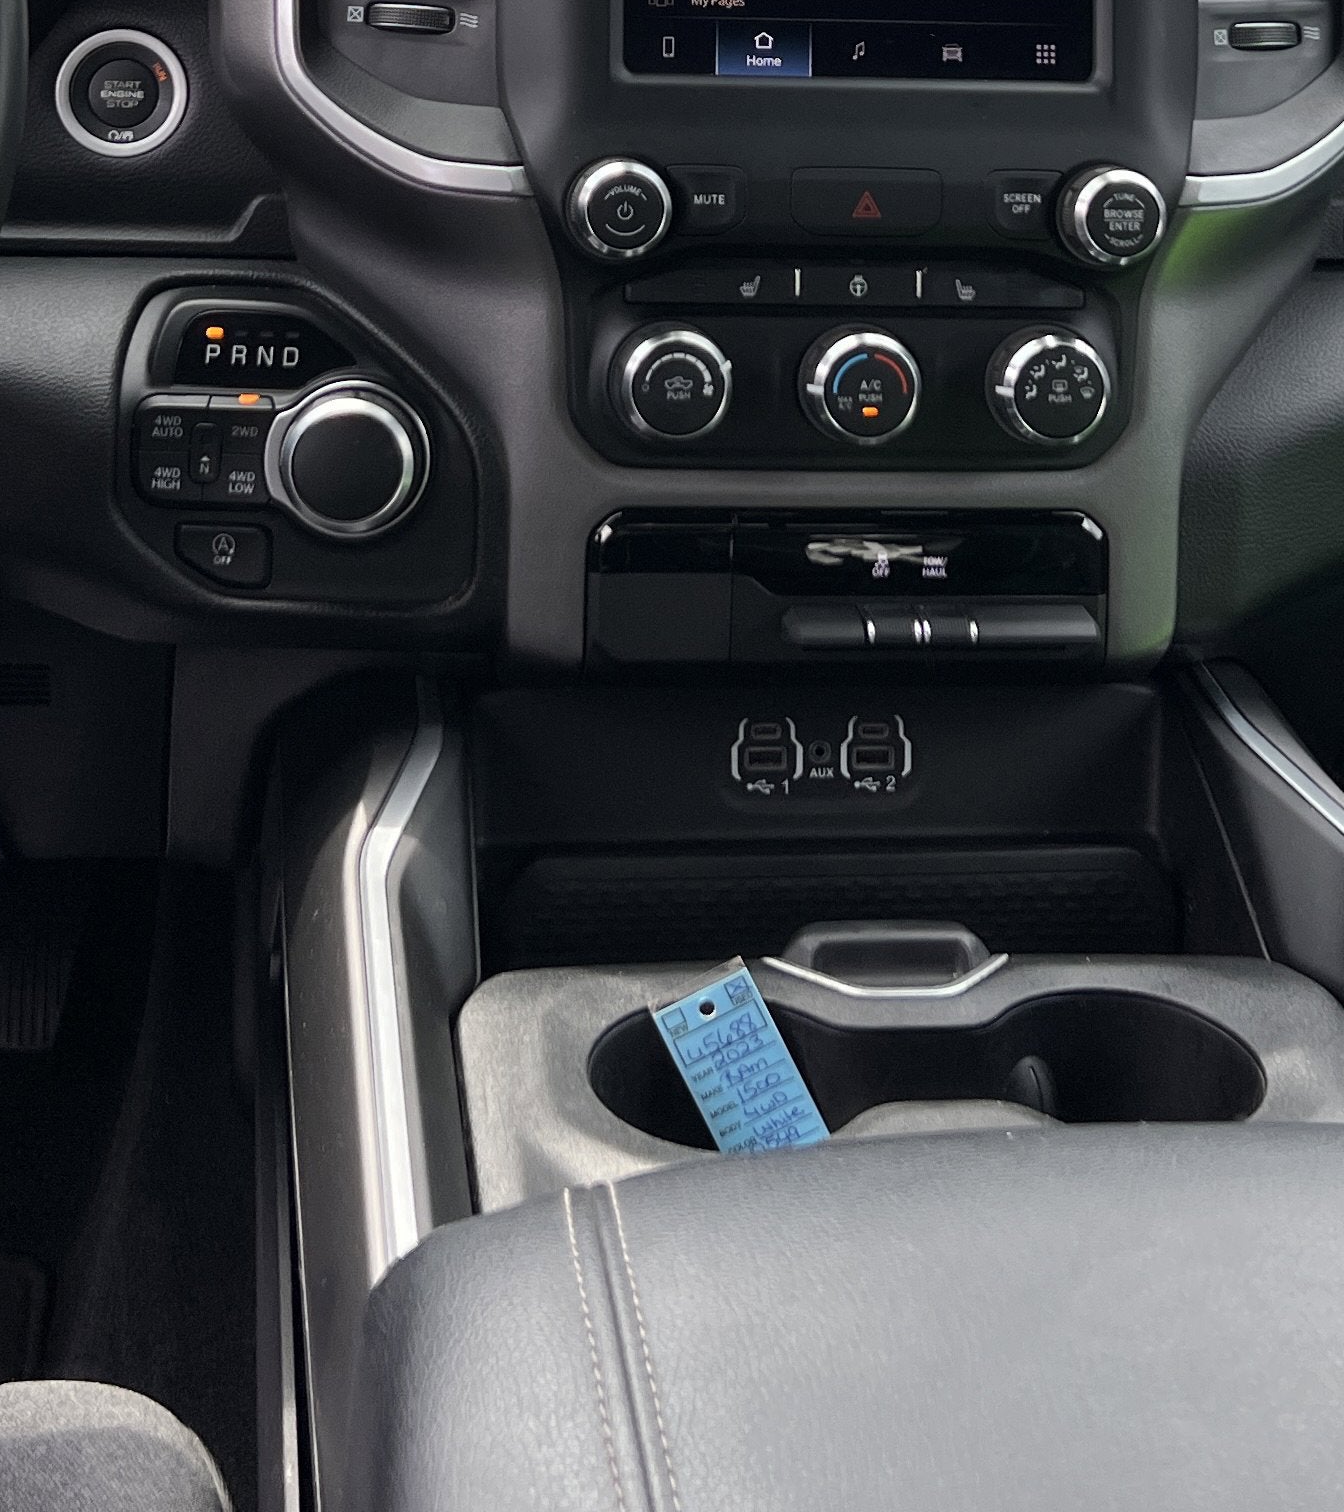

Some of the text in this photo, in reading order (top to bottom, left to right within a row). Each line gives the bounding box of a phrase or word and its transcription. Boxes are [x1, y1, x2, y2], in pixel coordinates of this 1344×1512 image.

[746, 54, 782, 67] Home
[103, 80, 142, 89] START
[100, 90, 145, 99] ENGINE
[106, 99, 139, 109] STOP
[609, 183, 643, 197] VOLUME
[693, 193, 726, 206] MUTE
[1003, 192, 1042, 204] SCREEN
[1113, 192, 1136, 202] TUNE
[1011, 204, 1031, 214] OFF
[1103, 208, 1144, 219] BROWSE
[1109, 220, 1141, 231] ENTER
[1108, 237, 1140, 248] SCROLL
[204, 343, 300, 367] P R N D
[860, 379, 882, 390] A/C
[666, 390, 691, 400] PUSH
[859, 393, 883, 402] PUSH
[1048, 393, 1072, 403] PUSH
[154, 415, 182, 426] 4WD
[151, 426, 184, 438] AUTO
[230, 425, 259, 437] 2WD
[154, 467, 181, 479] 4WD
[228, 470, 256, 482] 4WD
[150, 478, 181, 490] HIGH
[228, 482, 255, 494] LOW
[212, 555, 233, 565] OFF
[922, 567, 948, 578] HAUL
[809, 767, 834, 778] AUX
[780, 778, 790, 795] 1
[885, 775, 897, 792] 2
